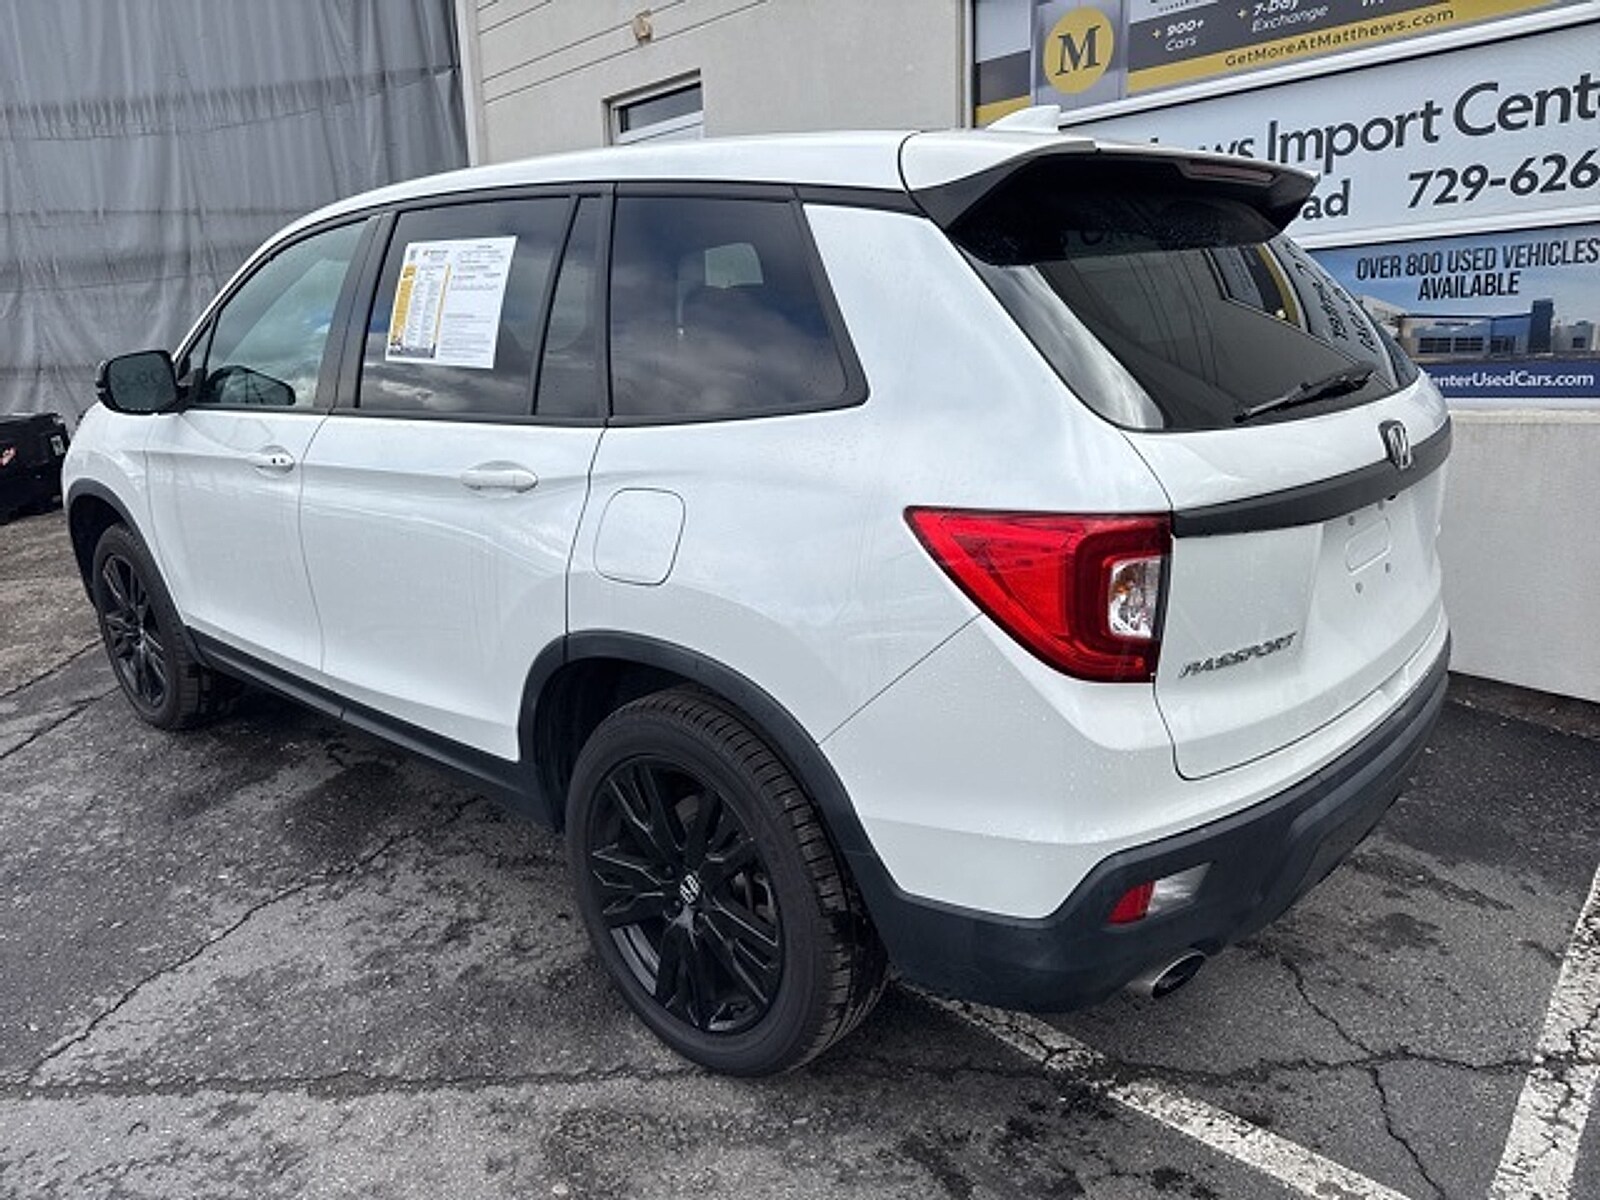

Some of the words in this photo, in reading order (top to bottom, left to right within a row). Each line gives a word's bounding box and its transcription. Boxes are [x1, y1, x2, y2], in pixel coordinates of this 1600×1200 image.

[1225, 9, 1455, 66] GetMoreAtMatthews.com
[1252, 5, 1328, 32] Exchange
[1055, 25, 1101, 76] M
[1165, 36, 1197, 52] Cars
[1267, 99, 1443, 174] Import
[1453, 72, 1600, 136] Cent
[1301, 178, 1350, 220] ad
[1407, 148, 1600, 208] 729-626
[1356, 255, 1401, 281] OVER
[1405, 252, 1442, 277] 800
[1447, 246, 1497, 273] USED
[1502, 237, 1600, 269] VEHICLES
[1417, 271, 1521, 301] AVAILABLE
[1429, 370, 1595, 388] enterUsedCars.com
[1178, 631, 1298, 679] PASSPORT
